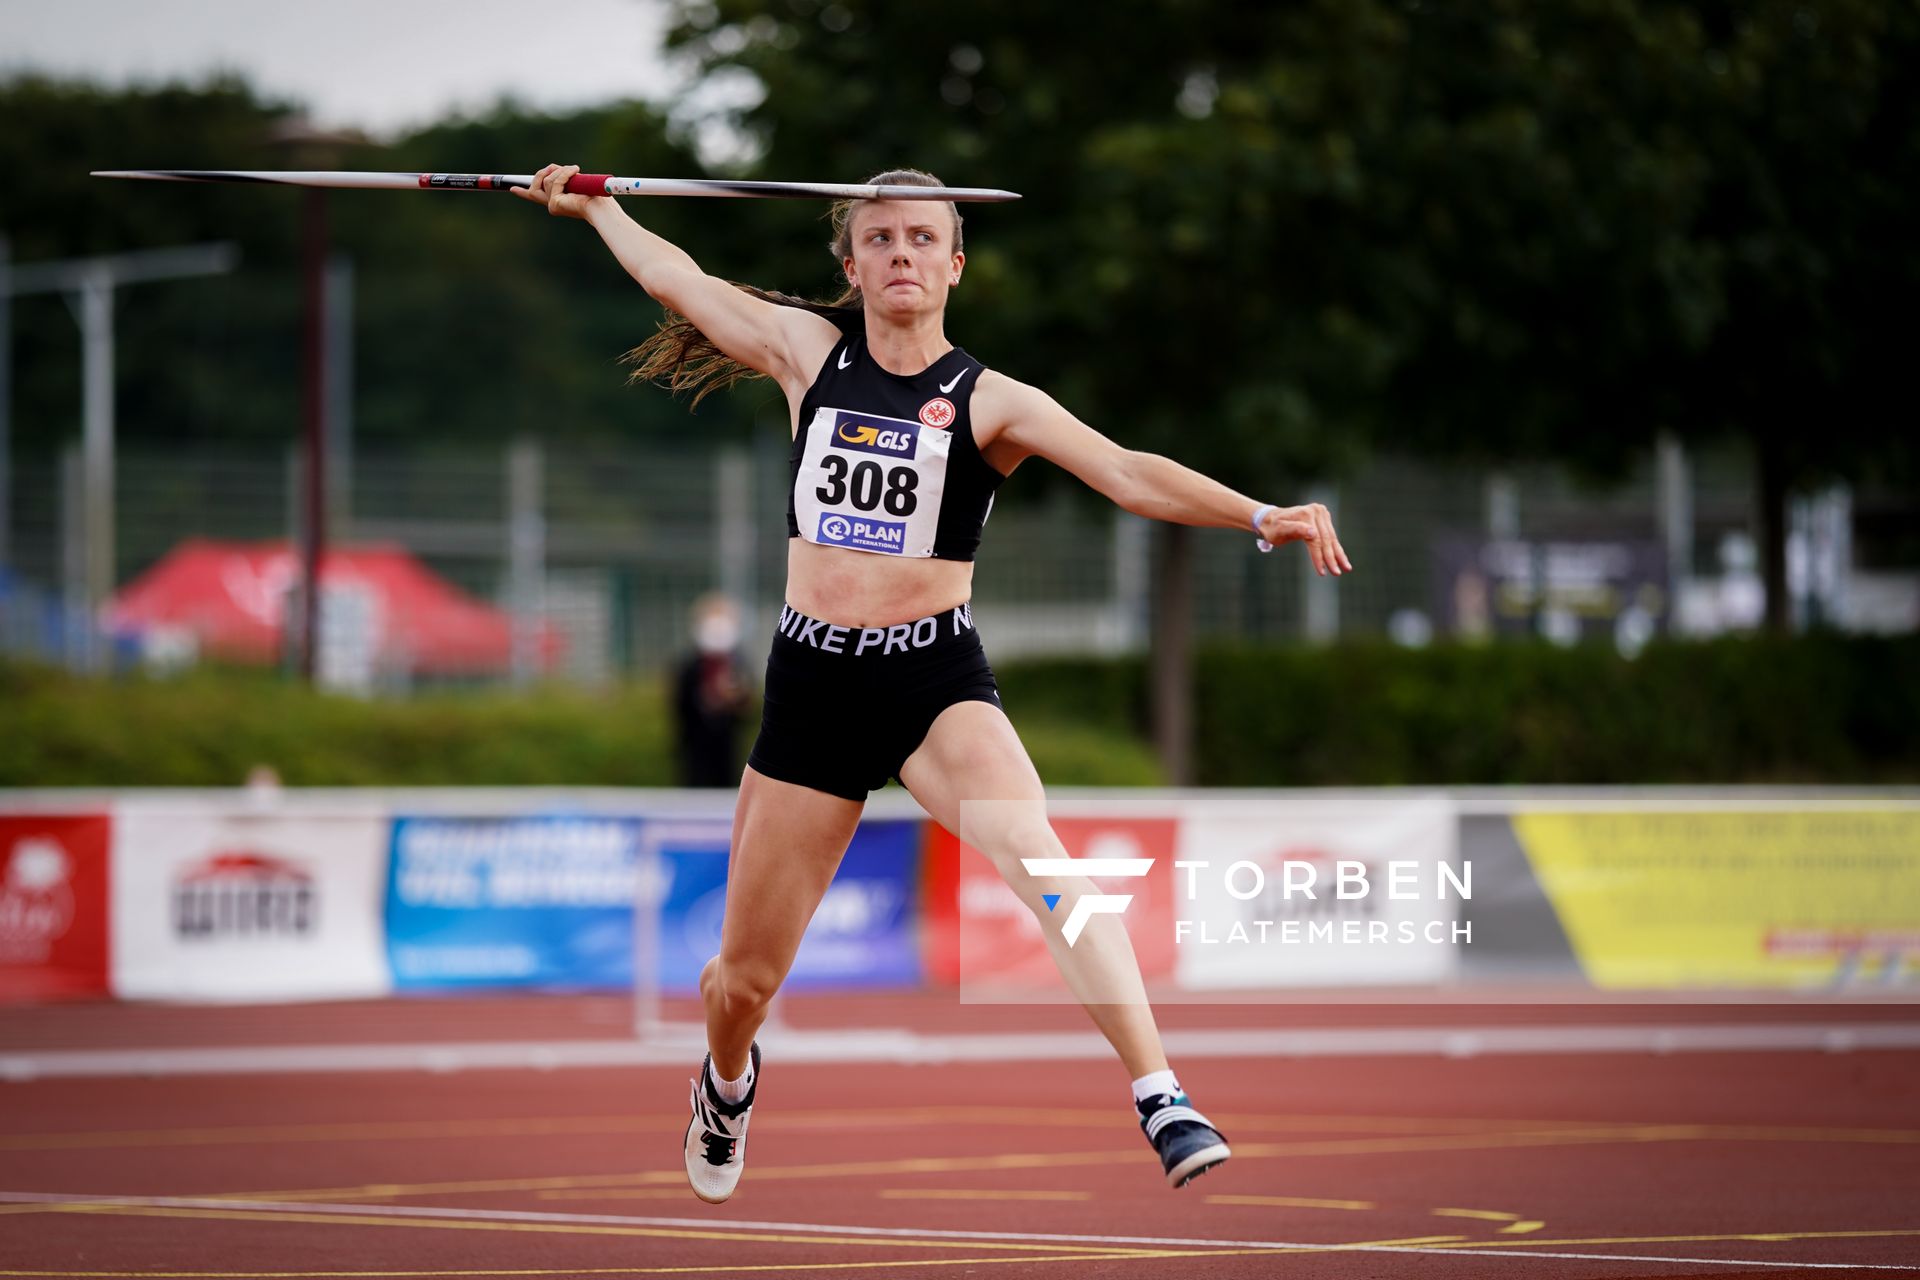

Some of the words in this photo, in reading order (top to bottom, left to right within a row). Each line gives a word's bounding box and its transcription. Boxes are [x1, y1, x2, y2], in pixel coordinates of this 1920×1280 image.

[877, 431, 910, 451] GLS
[816, 455, 919, 516] 308
[853, 522, 902, 543] PLAN
[852, 538, 900, 550] INTERNATIONAL
[779, 604, 850, 654] NIKE
[855, 616, 937, 656] PRO
